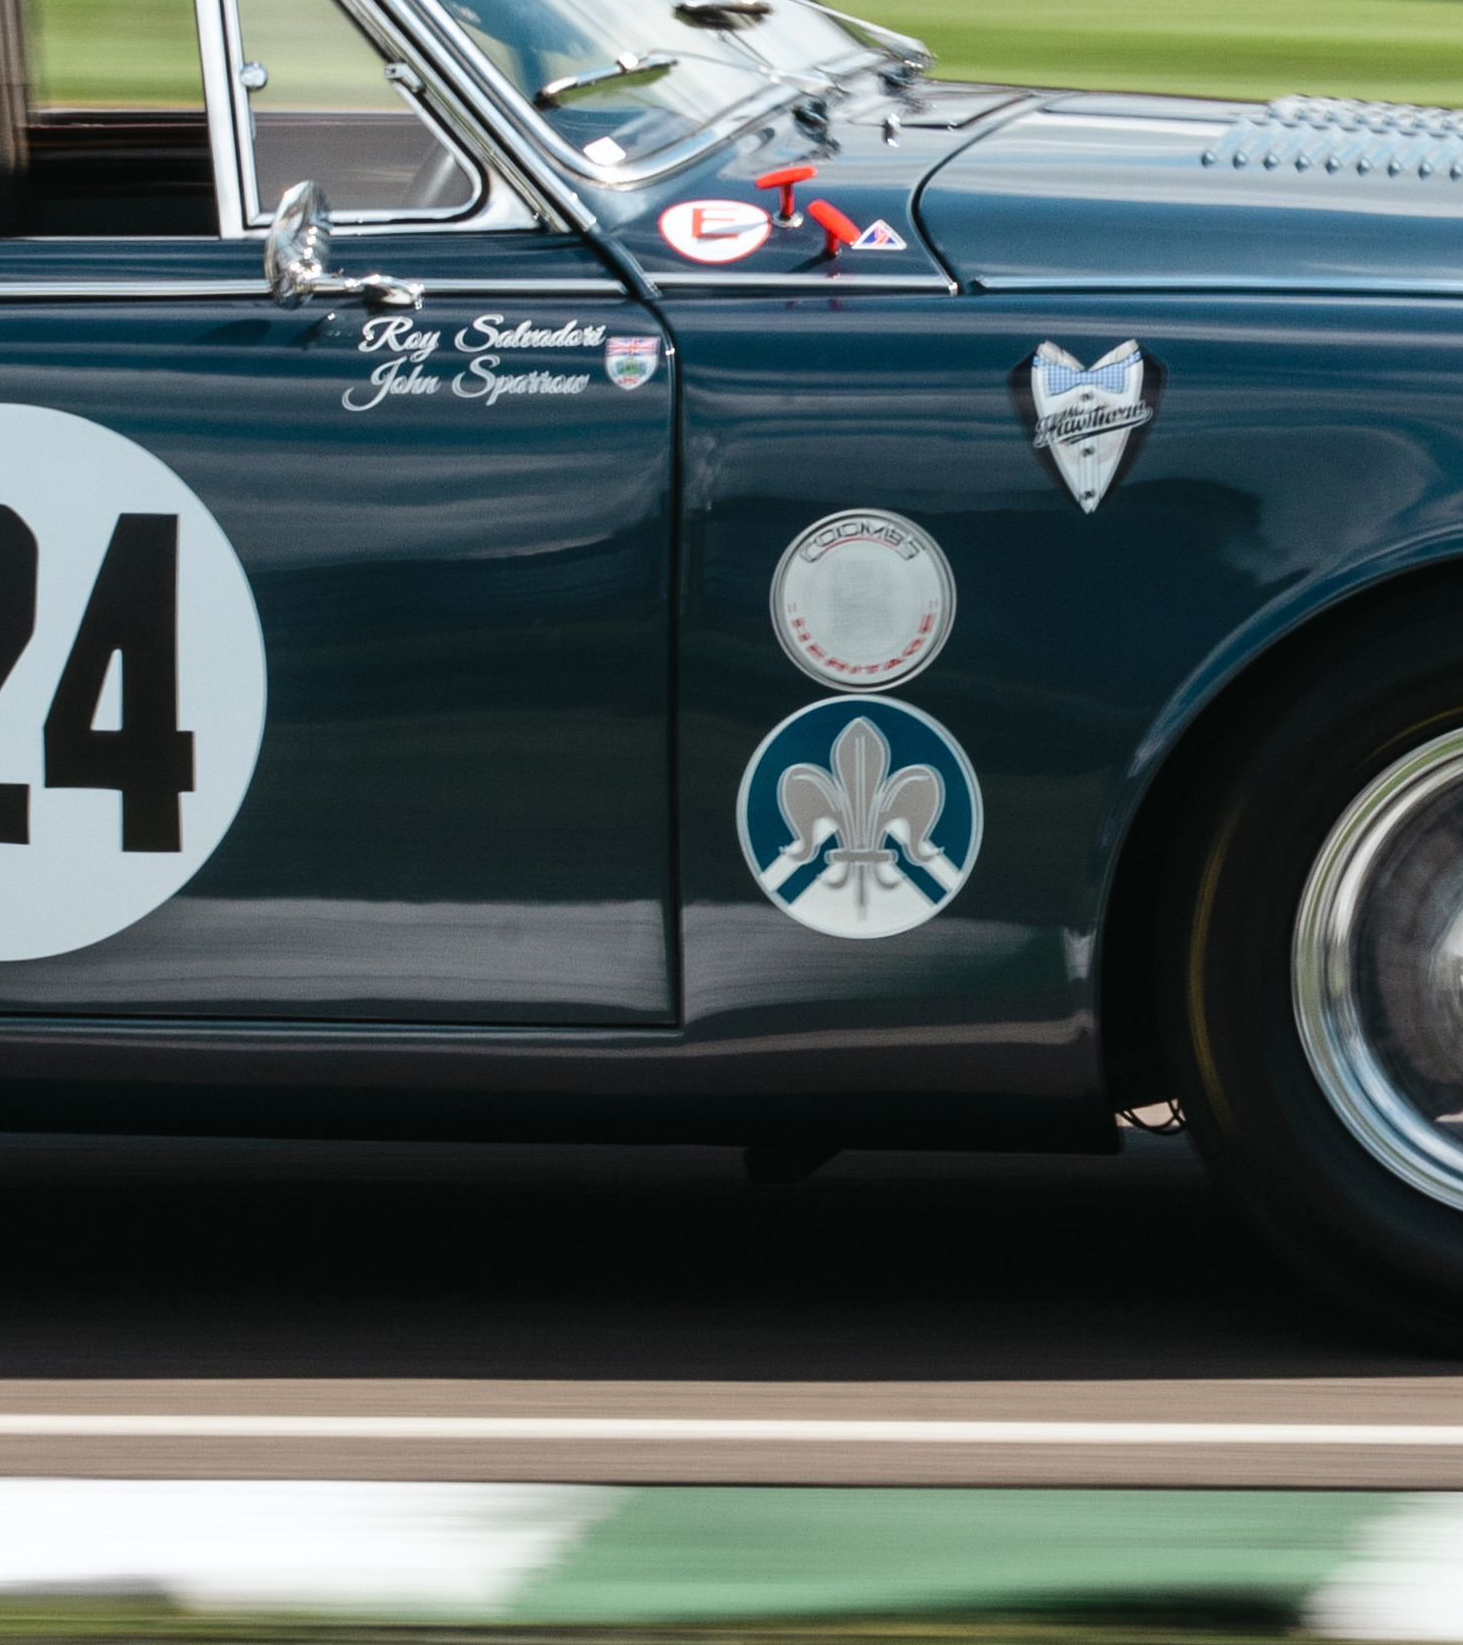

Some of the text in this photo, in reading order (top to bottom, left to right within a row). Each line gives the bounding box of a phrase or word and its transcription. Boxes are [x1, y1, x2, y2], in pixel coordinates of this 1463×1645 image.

[692, 207, 741, 239] E
[358, 313, 607, 361] Roy Salvadori
[342, 355, 590, 411] John Sparrow
